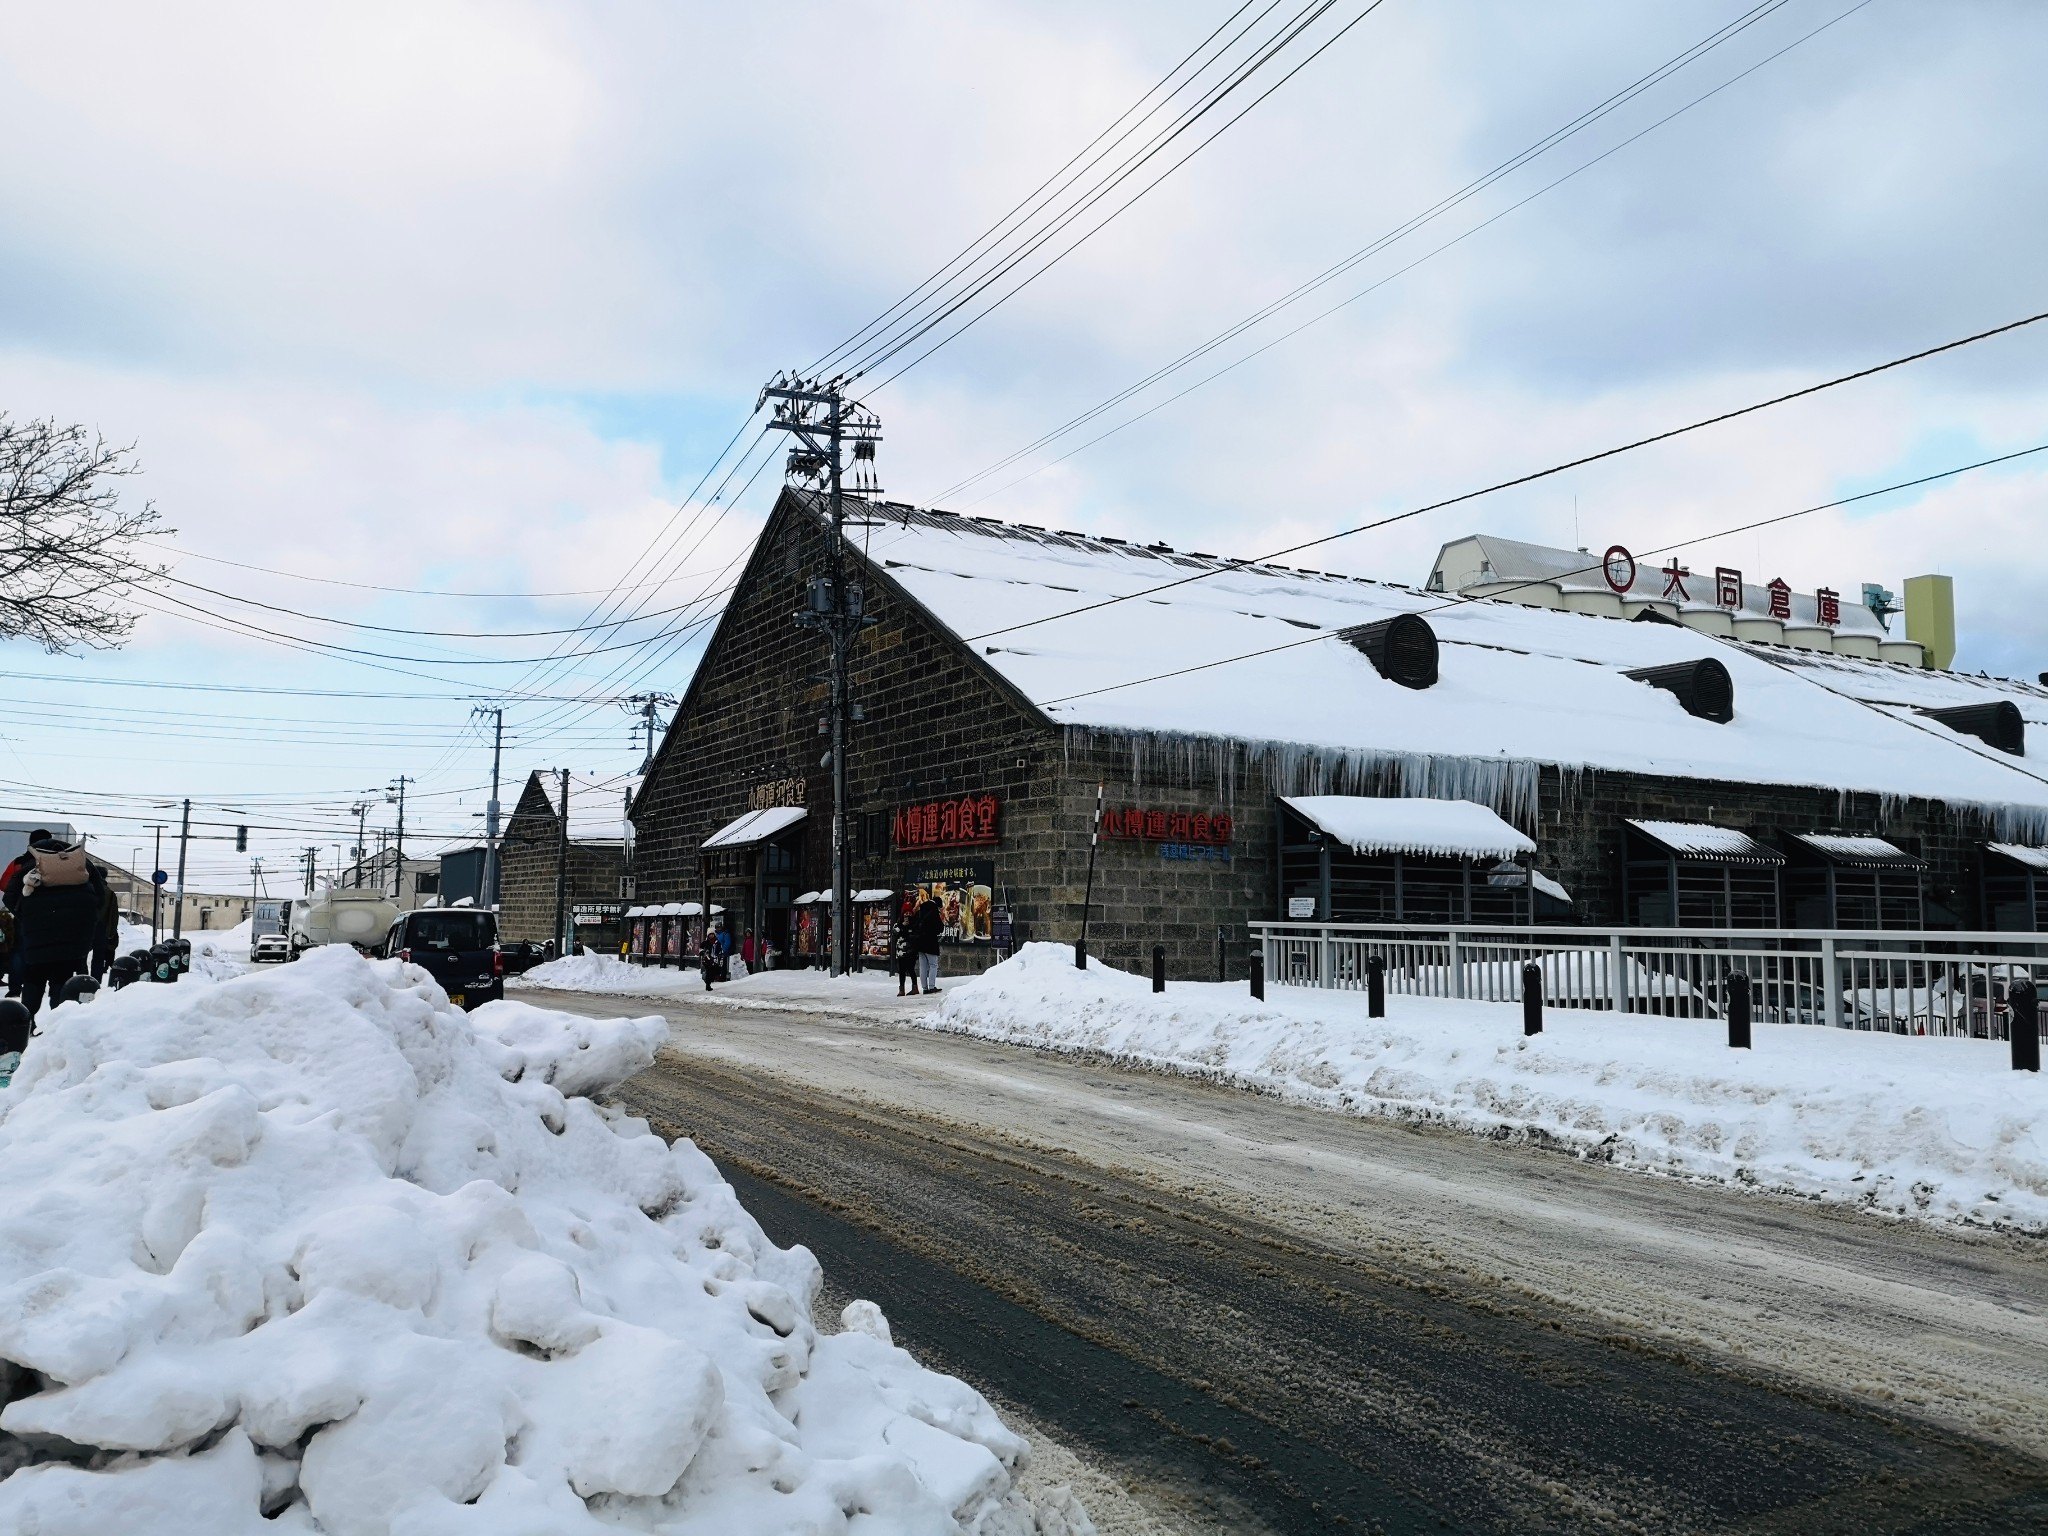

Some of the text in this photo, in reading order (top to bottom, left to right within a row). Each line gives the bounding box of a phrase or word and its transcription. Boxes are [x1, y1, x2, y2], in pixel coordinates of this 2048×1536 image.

[1661, 556, 1841, 628] 大同倉庫
[748, 777, 806, 810] 小樽運河食堂
[891, 795, 996, 848] 小樽運河食堂
[1103, 808, 1232, 841] 小樽運河食堂
